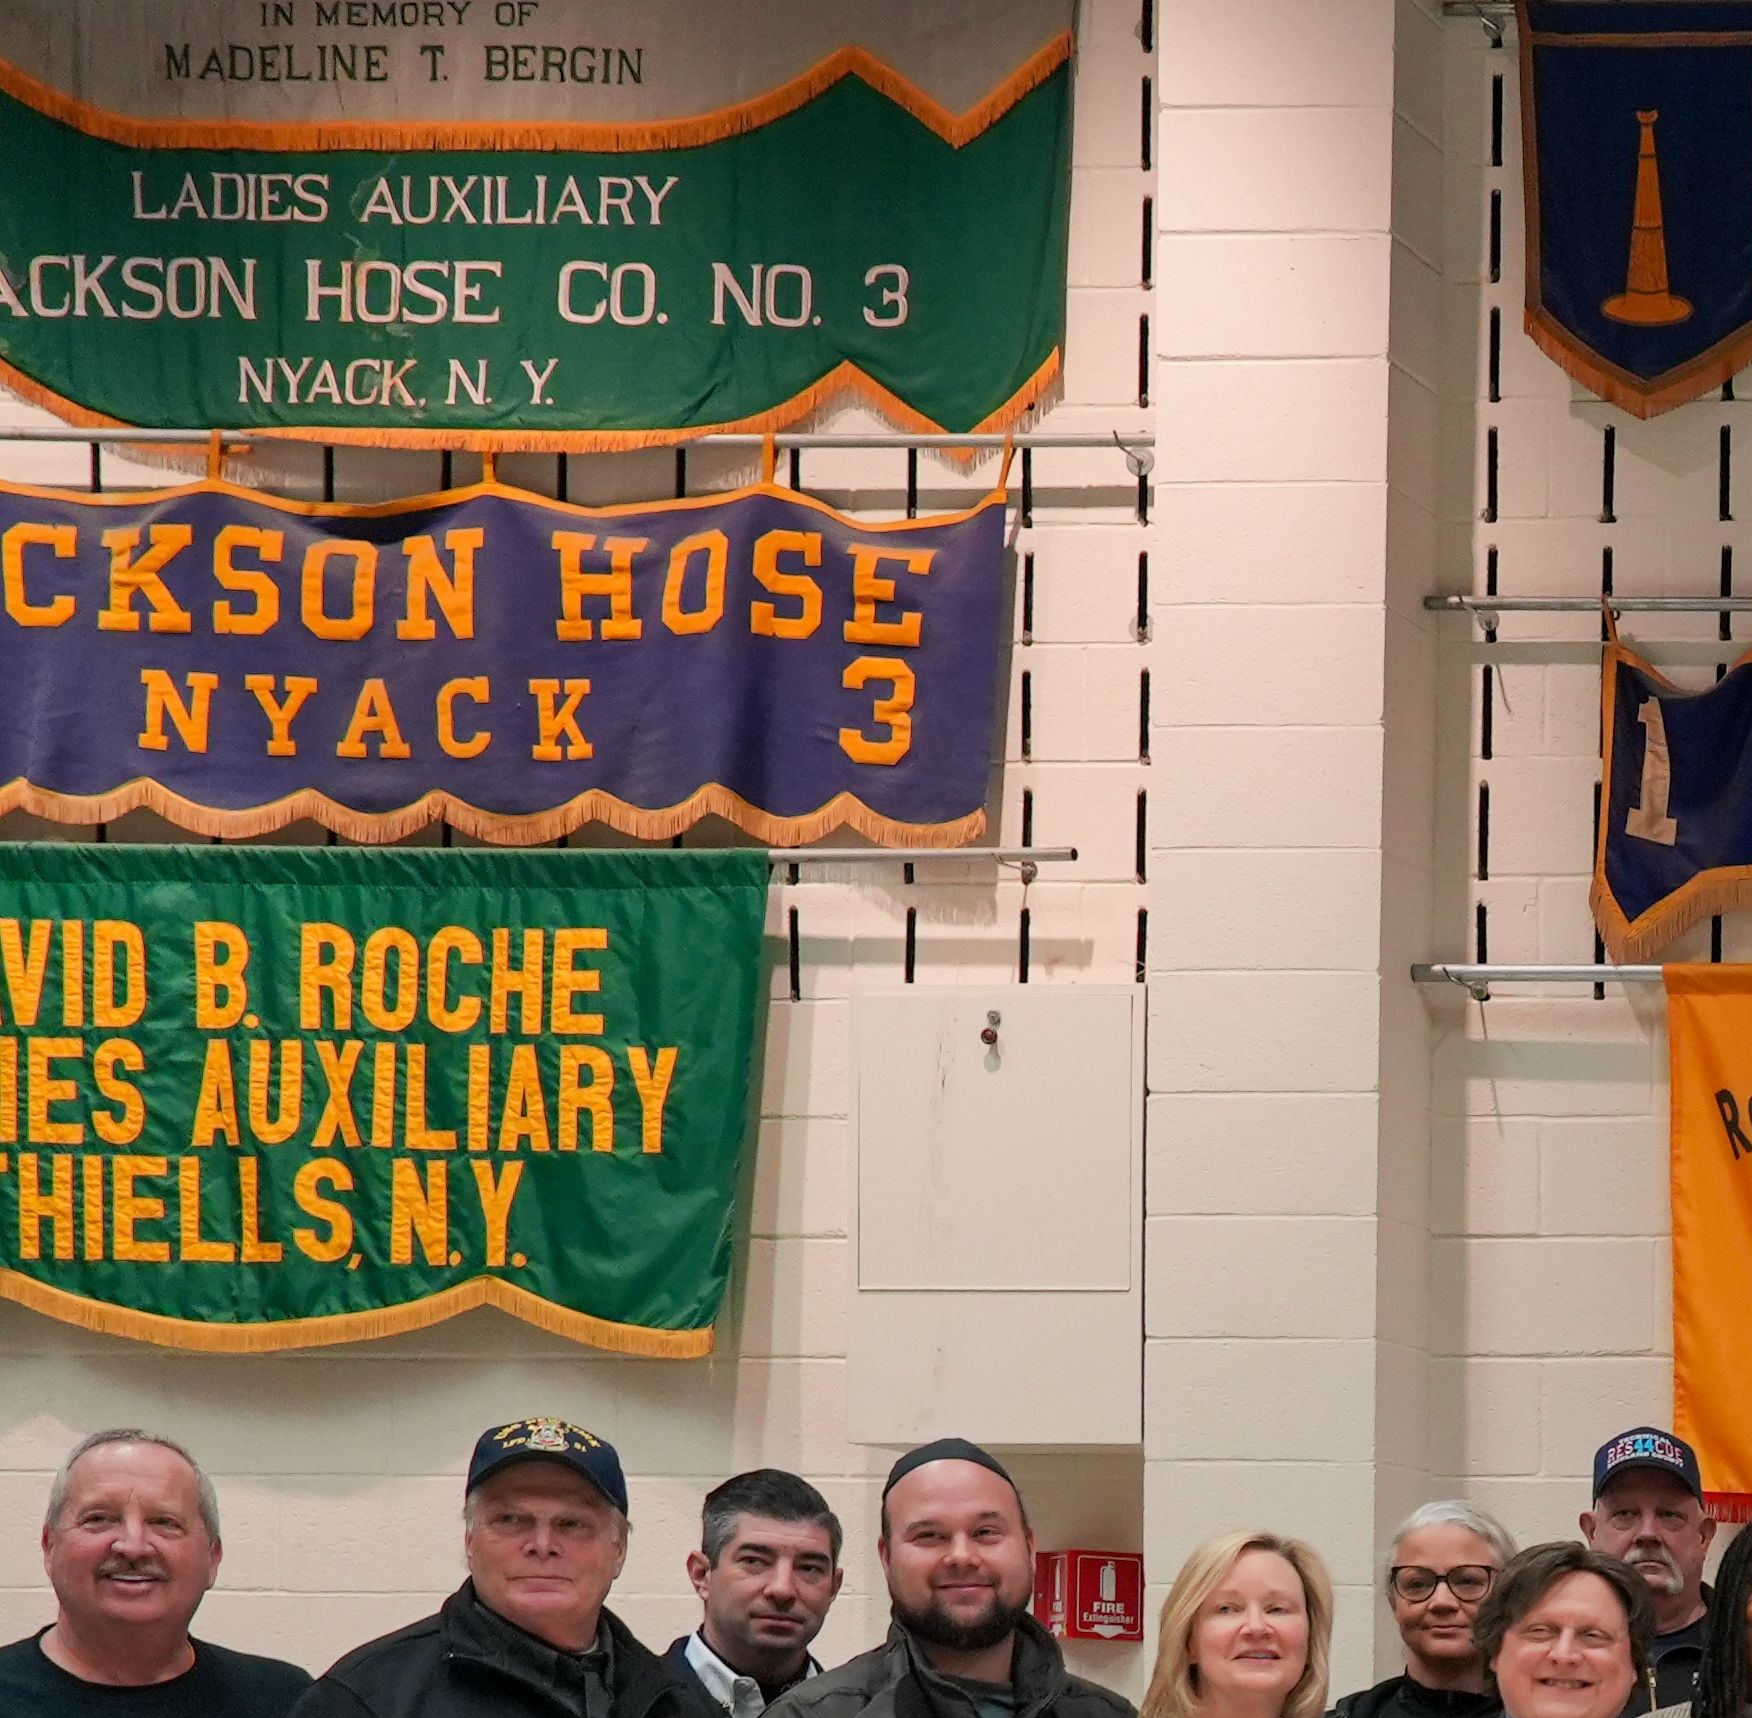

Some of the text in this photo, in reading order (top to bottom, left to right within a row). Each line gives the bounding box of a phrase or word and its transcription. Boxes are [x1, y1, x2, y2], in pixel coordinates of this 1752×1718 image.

[261, 2, 540, 26] IN MEMORY OF
[166, 45, 645, 86] MADELINE T. BERGIN
[132, 172, 679, 227] LADIES AUXILIARY
[307, 261, 501, 324] HOSE
[558, 262, 668, 326] CO.
[713, 262, 821, 326] NO.
[863, 263, 909, 327] 3
[238, 356, 560, 409] NYACK, N. Y.
[552, 527, 935, 649] HOSE
[139, 656, 916, 766] NYACK 3
[1625, 697, 1679, 847] 1
[195, 921, 259, 1030] B.
[299, 922, 609, 1037] ROCHE
[192, 1037, 678, 1154] AUXILIARY
[0, 1154, 529, 1269] HIELLS, N.Y.
[1093, 1601, 1124, 1614] FIRE
